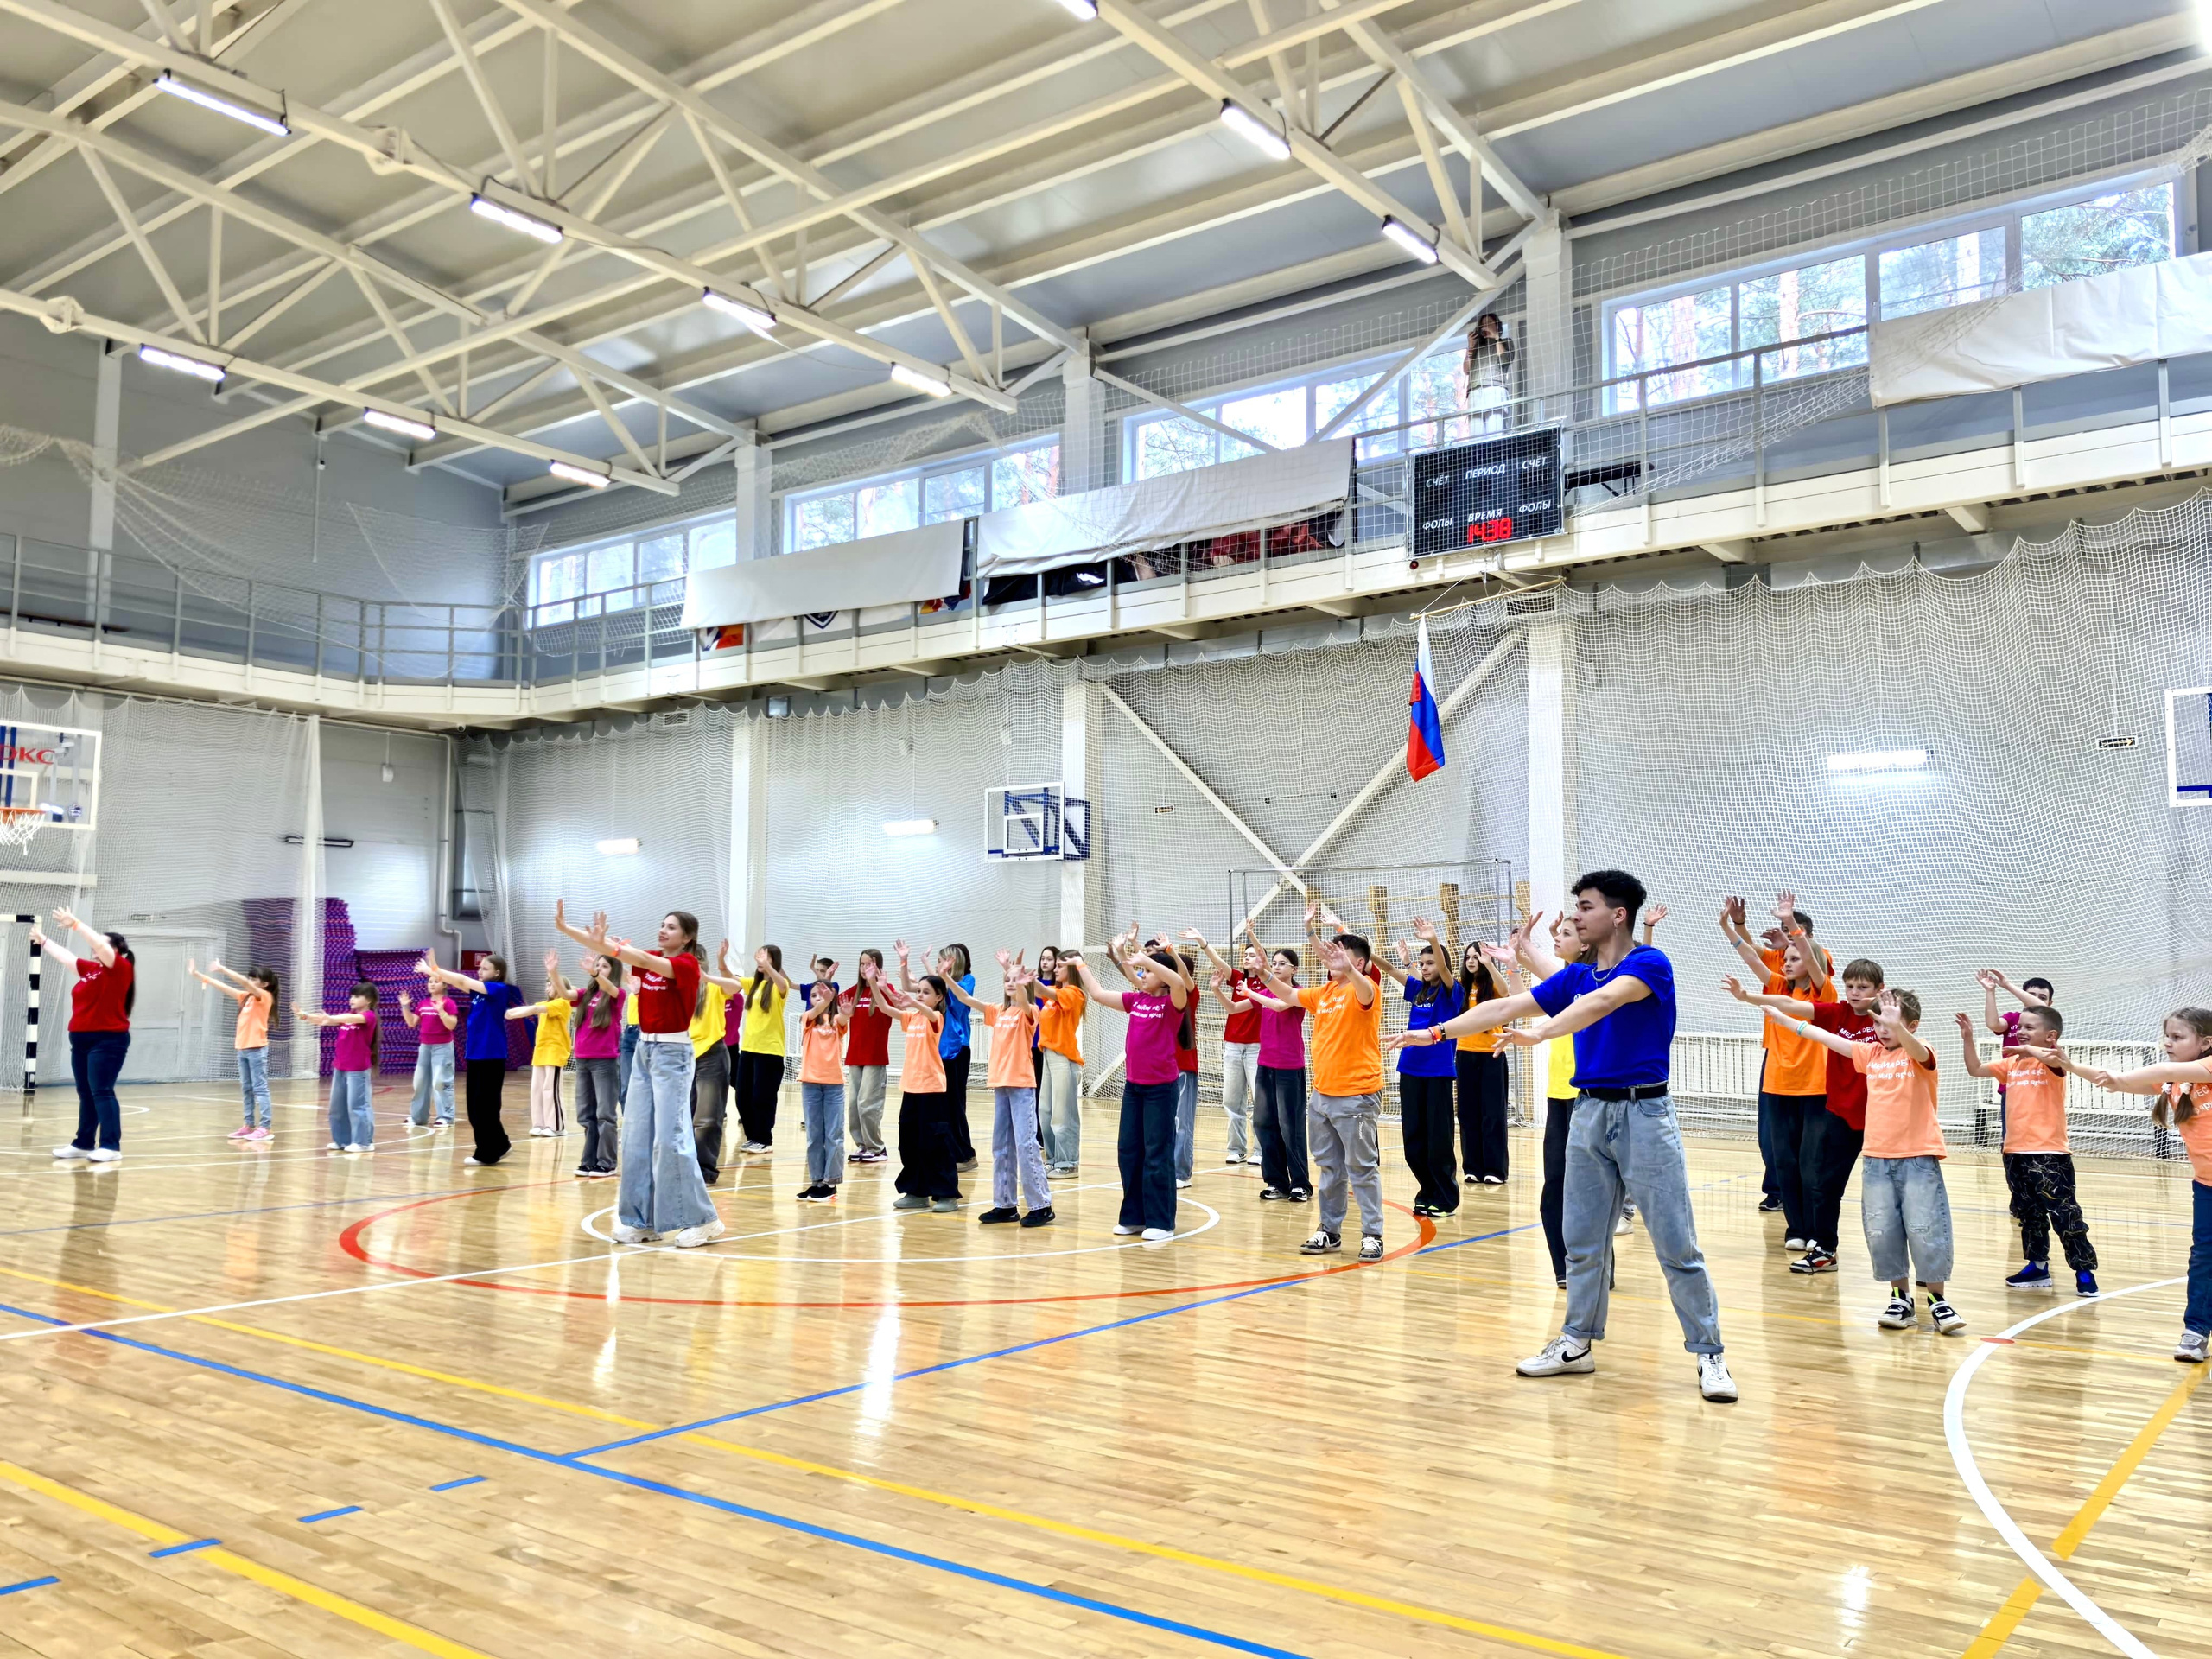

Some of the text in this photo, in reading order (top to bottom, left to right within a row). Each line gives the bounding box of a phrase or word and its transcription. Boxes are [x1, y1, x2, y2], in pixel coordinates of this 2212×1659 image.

[1522, 455, 1548, 469] СЧЁТ
[1465, 463, 1506, 480] ПЕРИОД
[1426, 474, 1450, 488] СЧЁТ
[1518, 499, 1552, 513] ФОЛЫ
[1467, 508, 1503, 522] ВРЕМЯ
[1422, 517, 1452, 531] ФОЛЫ
